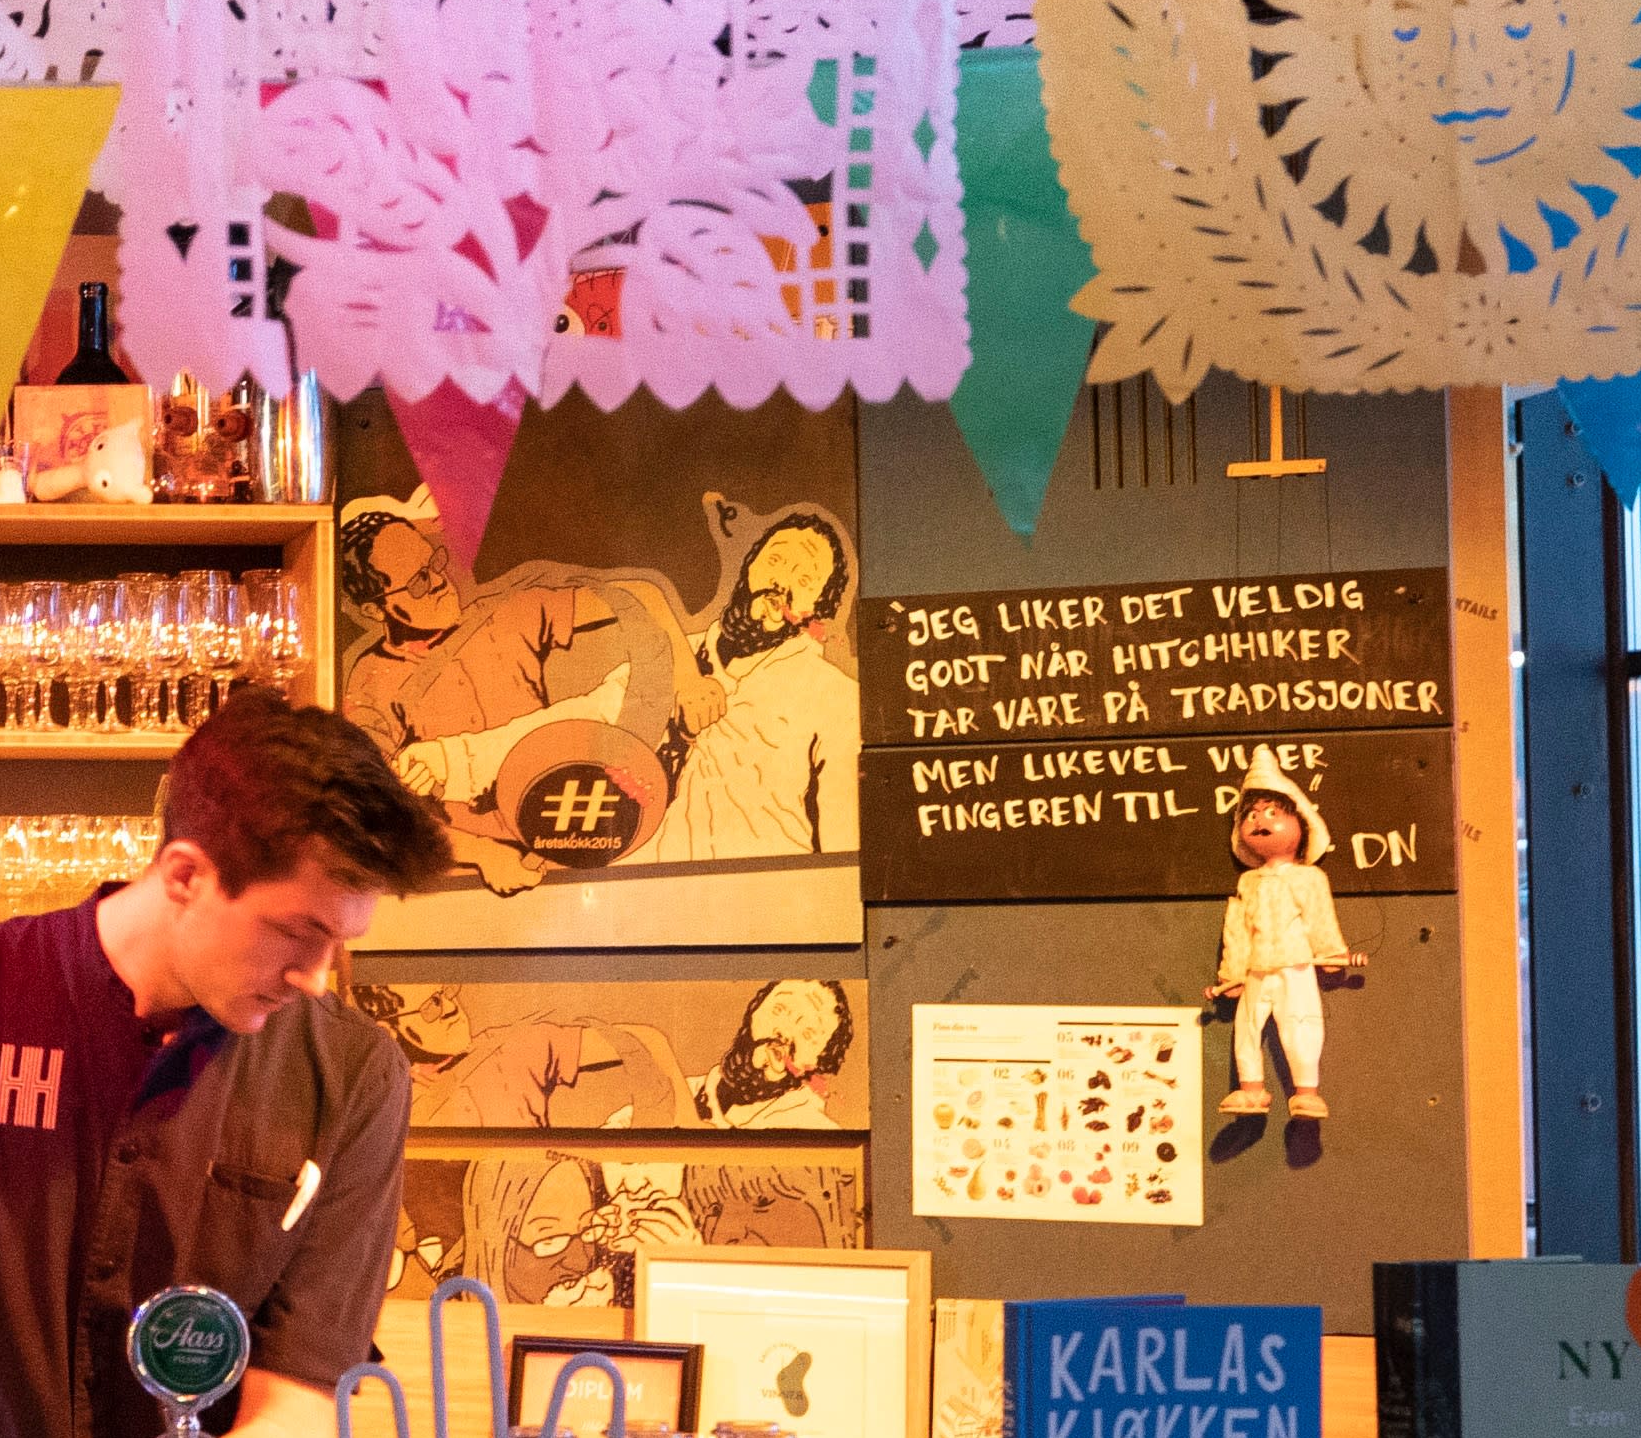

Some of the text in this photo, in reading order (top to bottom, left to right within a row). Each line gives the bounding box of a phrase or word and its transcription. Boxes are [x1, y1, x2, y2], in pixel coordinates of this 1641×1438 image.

[998, 595, 1108, 635] LIKER
[1120, 587, 1193, 623] DET
[1213, 579, 1365, 620] VELDIG
[905, 628, 1362, 693] GODT NÅR HITCHHIKER
[906, 679, 1444, 738] TAR VARE PÅ TRADISJONER
[912, 743, 1328, 794] MEN LIKEVEL VIER
[918, 791, 1103, 837] FINGEREN
[1112, 787, 1198, 823] TIL
[152, 1316, 226, 1351] Aass
[1049, 1322, 1287, 1402] KARLAS
[1557, 1340, 1631, 1380] NY
[564, 1378, 644, 1402] DIPLM
[1567, 1405, 1627, 1428] Even
